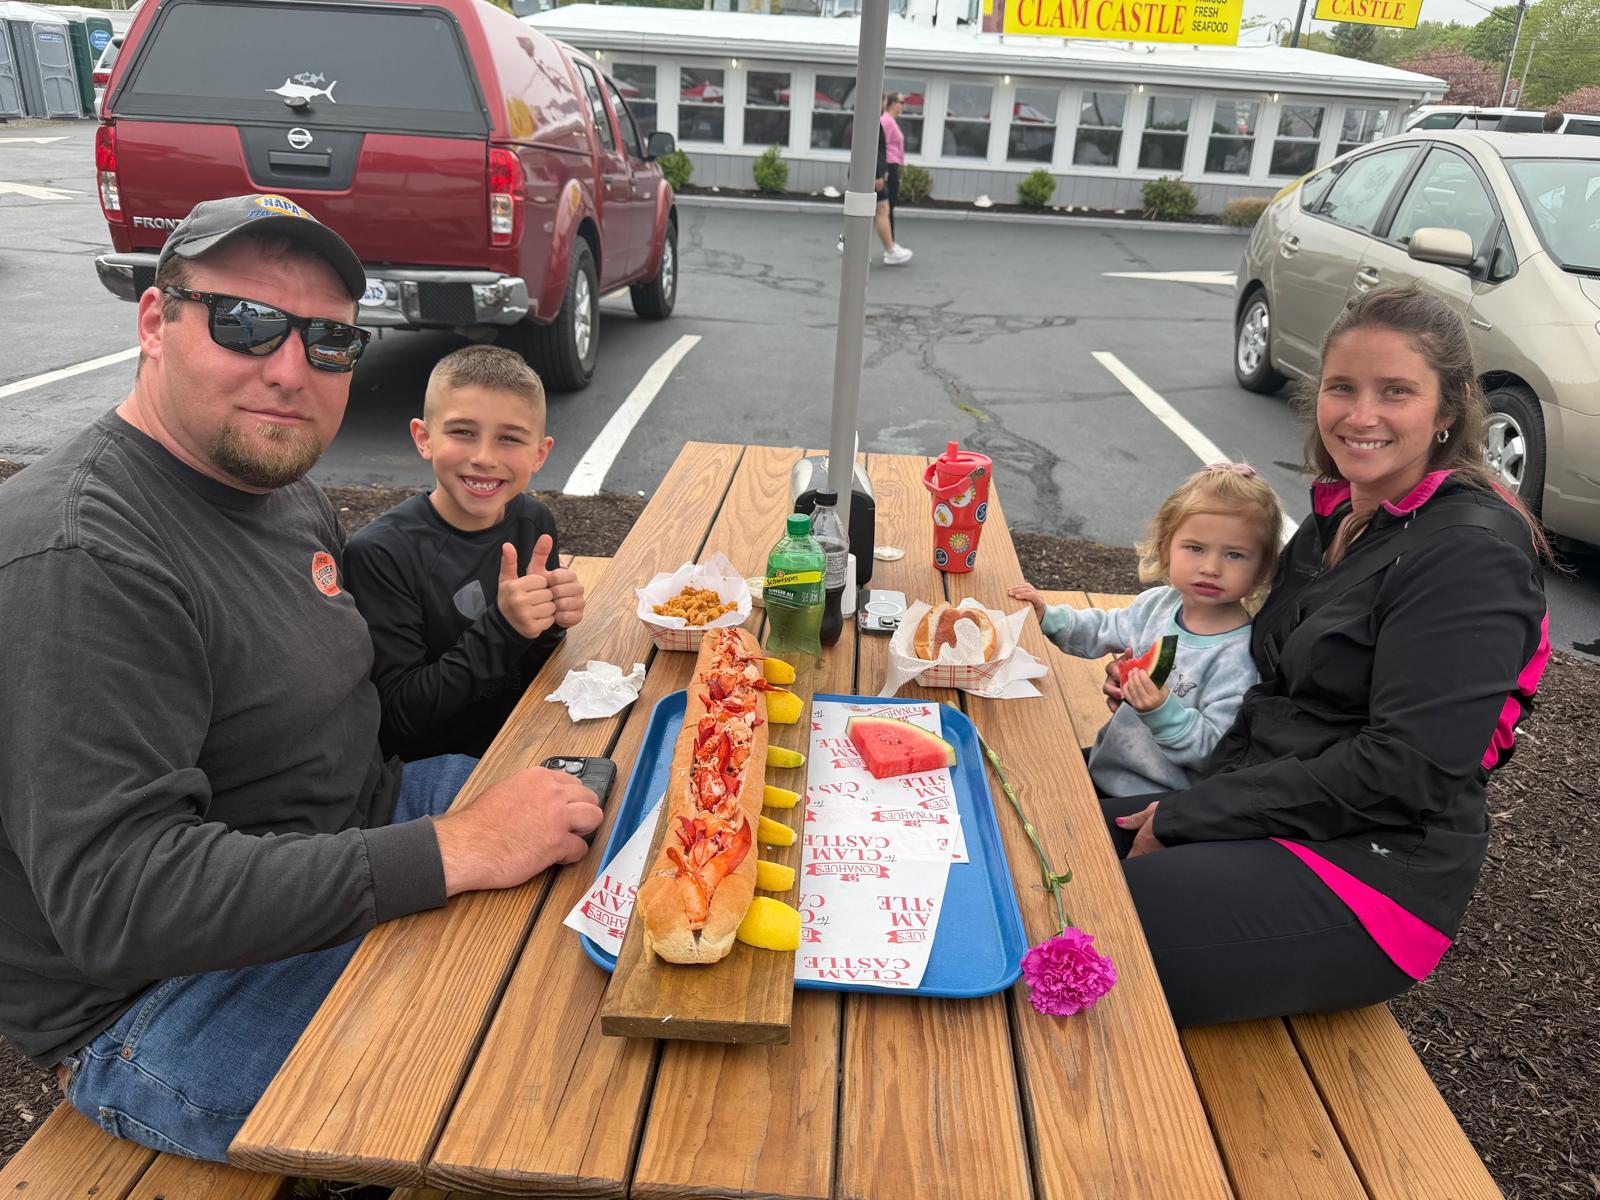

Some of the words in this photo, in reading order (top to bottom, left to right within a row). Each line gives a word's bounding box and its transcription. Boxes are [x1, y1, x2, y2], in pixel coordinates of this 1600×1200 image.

[1194, 6, 1219, 18] FRESH
[1331, 0, 1406, 20] CASTLE
[1017, 0, 1090, 29] CLAM
[1096, 0, 1187, 35] CASTLE
[1192, 20, 1228, 33] SEAFOOD
[264, 198, 300, 216] NAPA
[766, 575, 799, 587] Schweppes
[804, 835, 890, 848] CASTLE
[812, 848, 882, 861] CLAM
[816, 863, 880, 874] DONAHUE'S
[804, 956, 911, 969] CASTLE
[819, 969, 902, 979] CLAM
